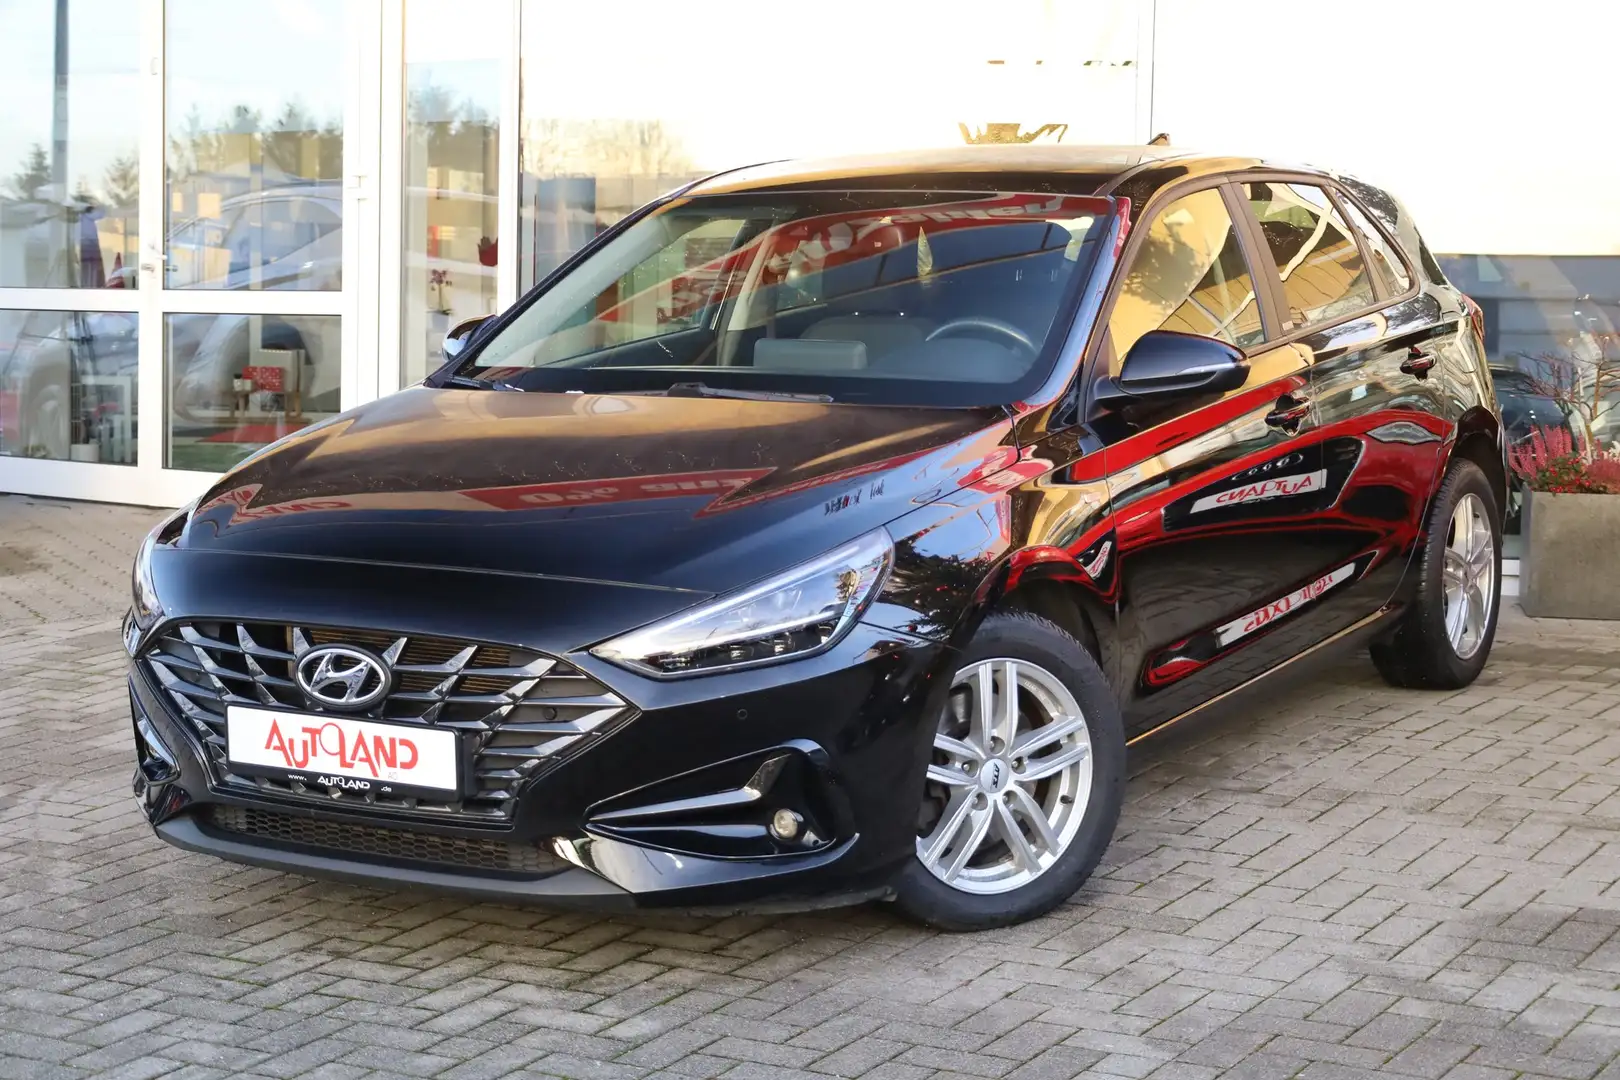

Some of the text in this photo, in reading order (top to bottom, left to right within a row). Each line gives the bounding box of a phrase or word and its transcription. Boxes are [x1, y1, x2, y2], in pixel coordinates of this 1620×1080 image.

[264, 718, 419, 778] AUTOLAND
[287, 773, 393, 793] www. AUTOLAND .de
